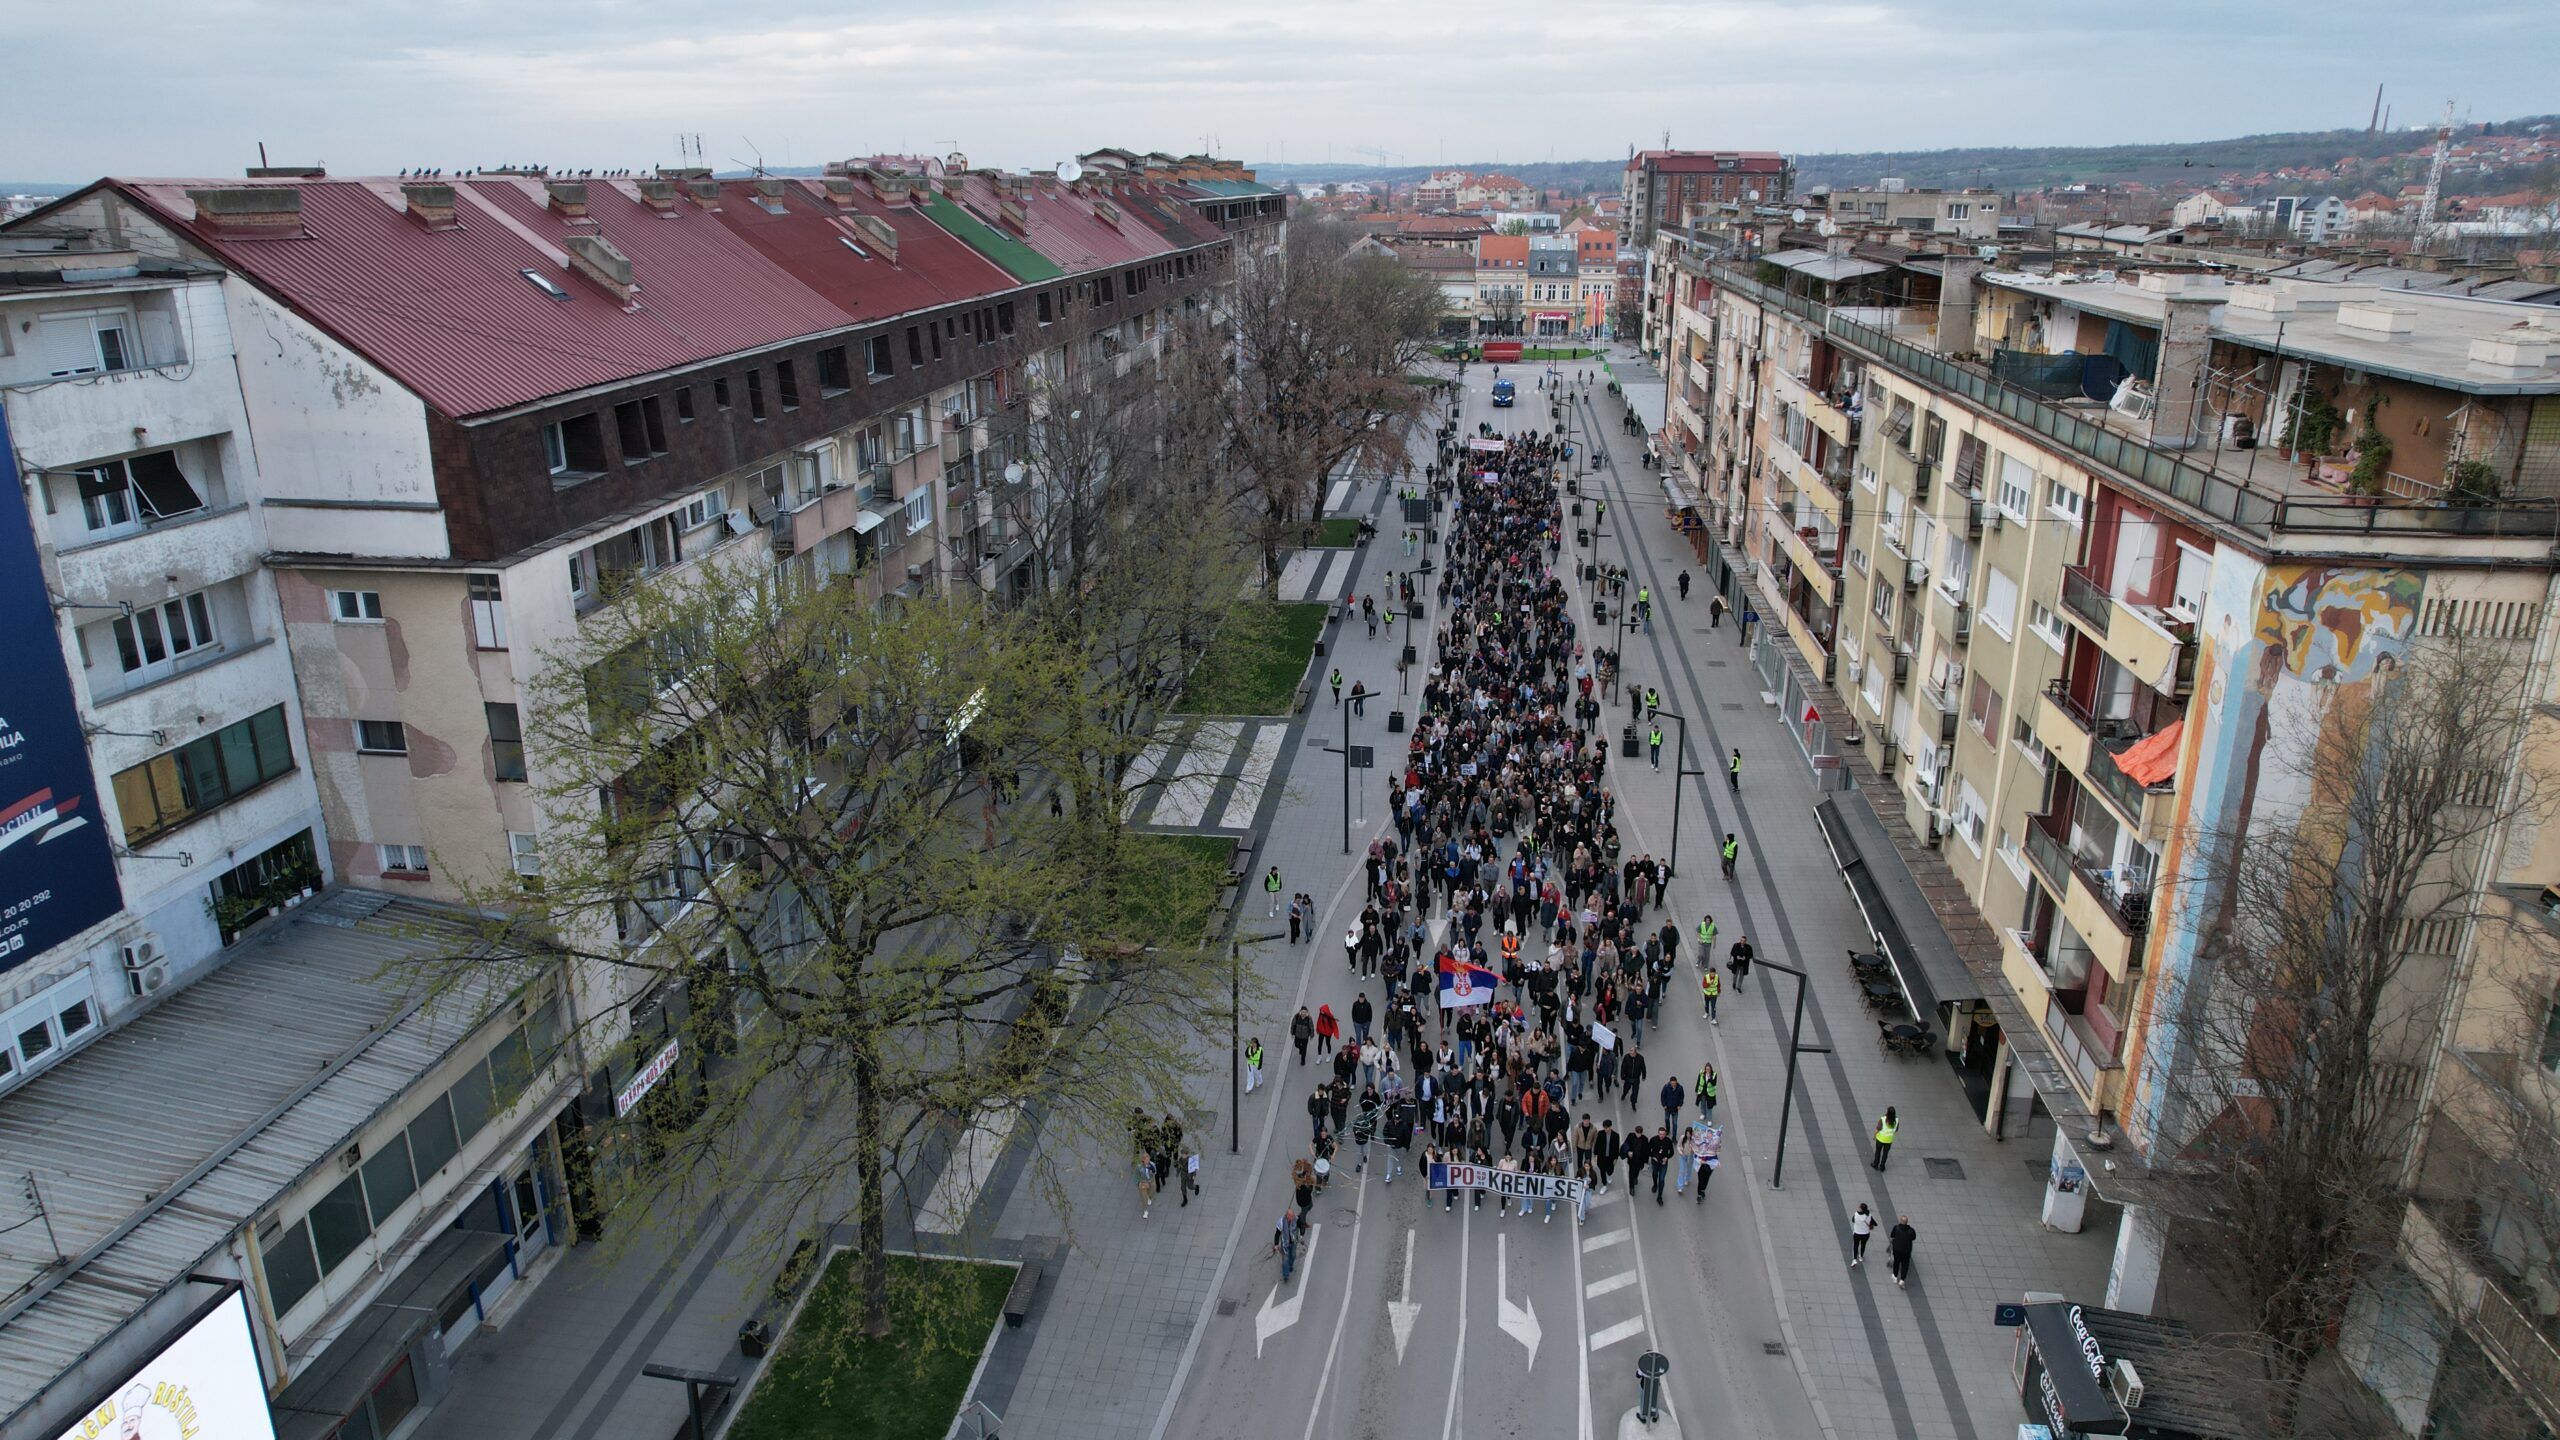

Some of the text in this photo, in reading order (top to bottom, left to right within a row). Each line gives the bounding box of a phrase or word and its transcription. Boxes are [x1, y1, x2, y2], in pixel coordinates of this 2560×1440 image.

[4, 889, 52, 919] 20 20 292
[0, 917, 29, 937] .co.rs
[1450, 1166, 1579, 1200] PO KRENI-SE
